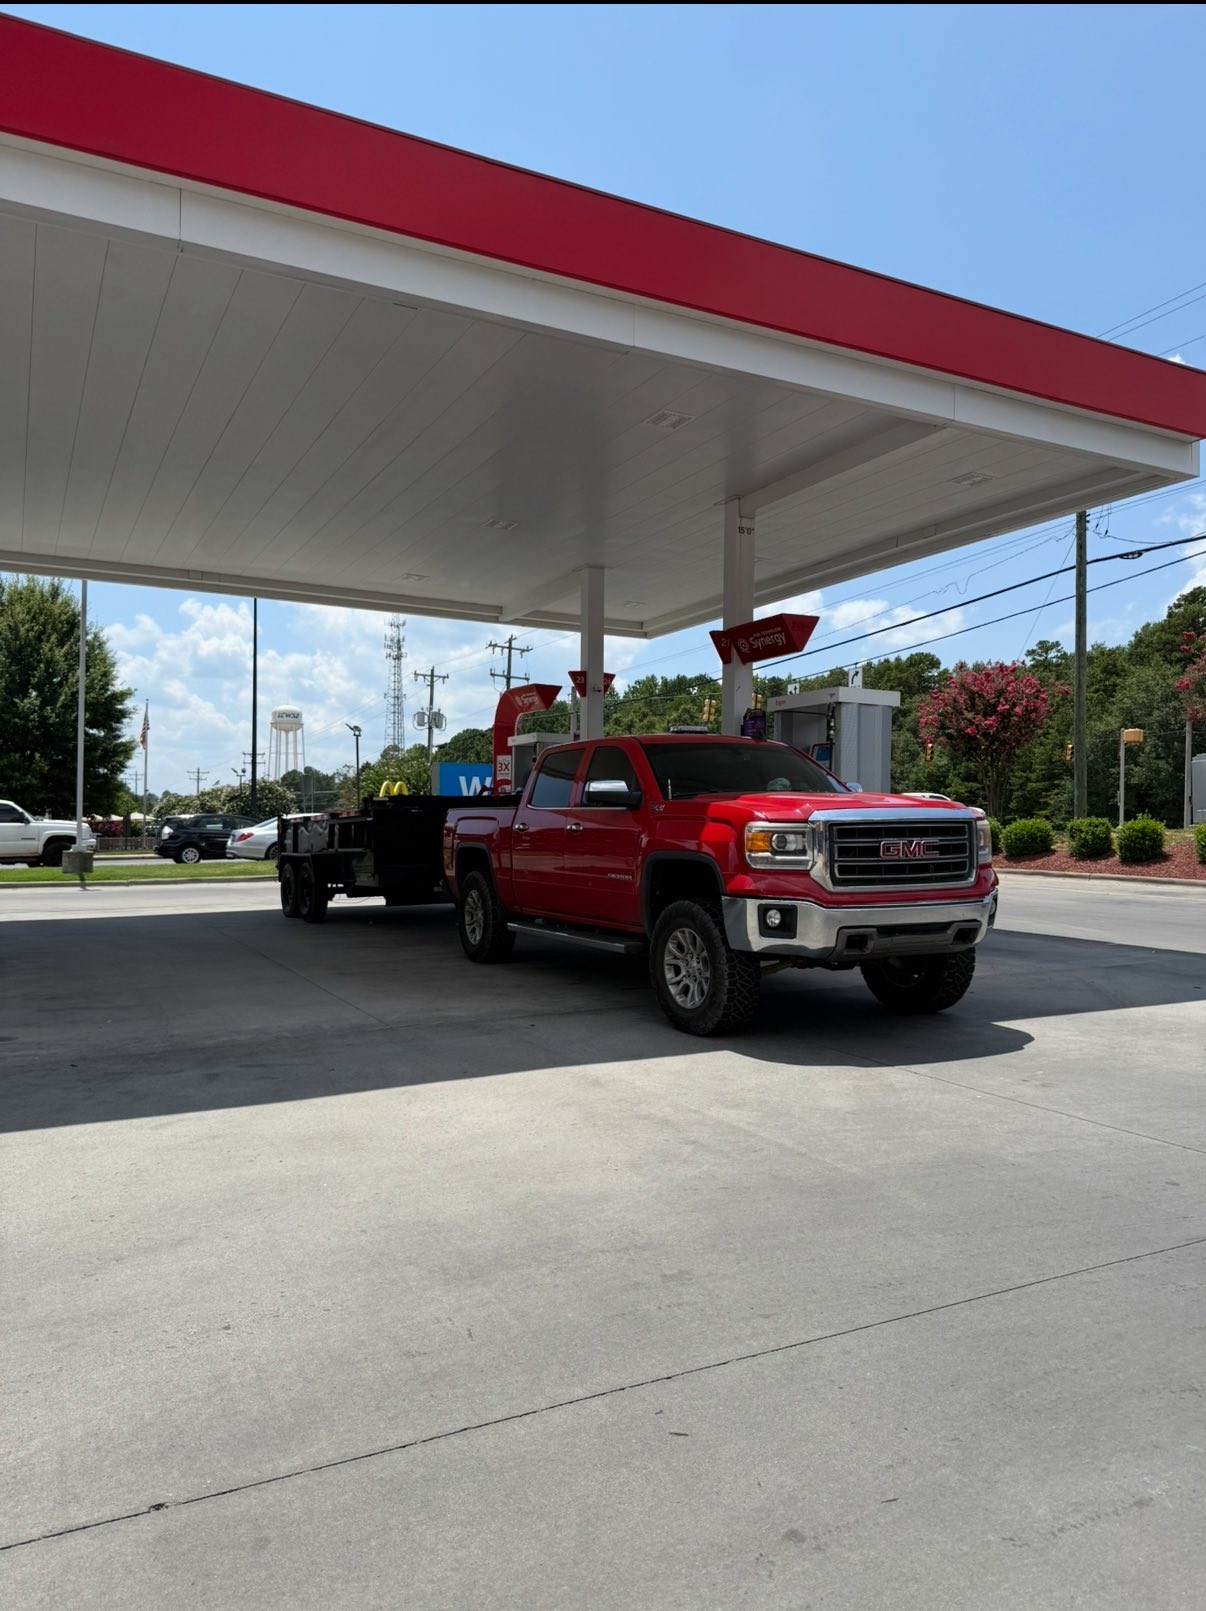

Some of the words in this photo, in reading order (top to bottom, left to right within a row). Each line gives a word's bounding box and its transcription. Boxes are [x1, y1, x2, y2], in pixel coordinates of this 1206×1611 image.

[721, 638, 730, 647] 21
[749, 632, 786, 650] Synergy
[498, 762, 510, 772] 3X
[880, 840, 940, 859] GMC
